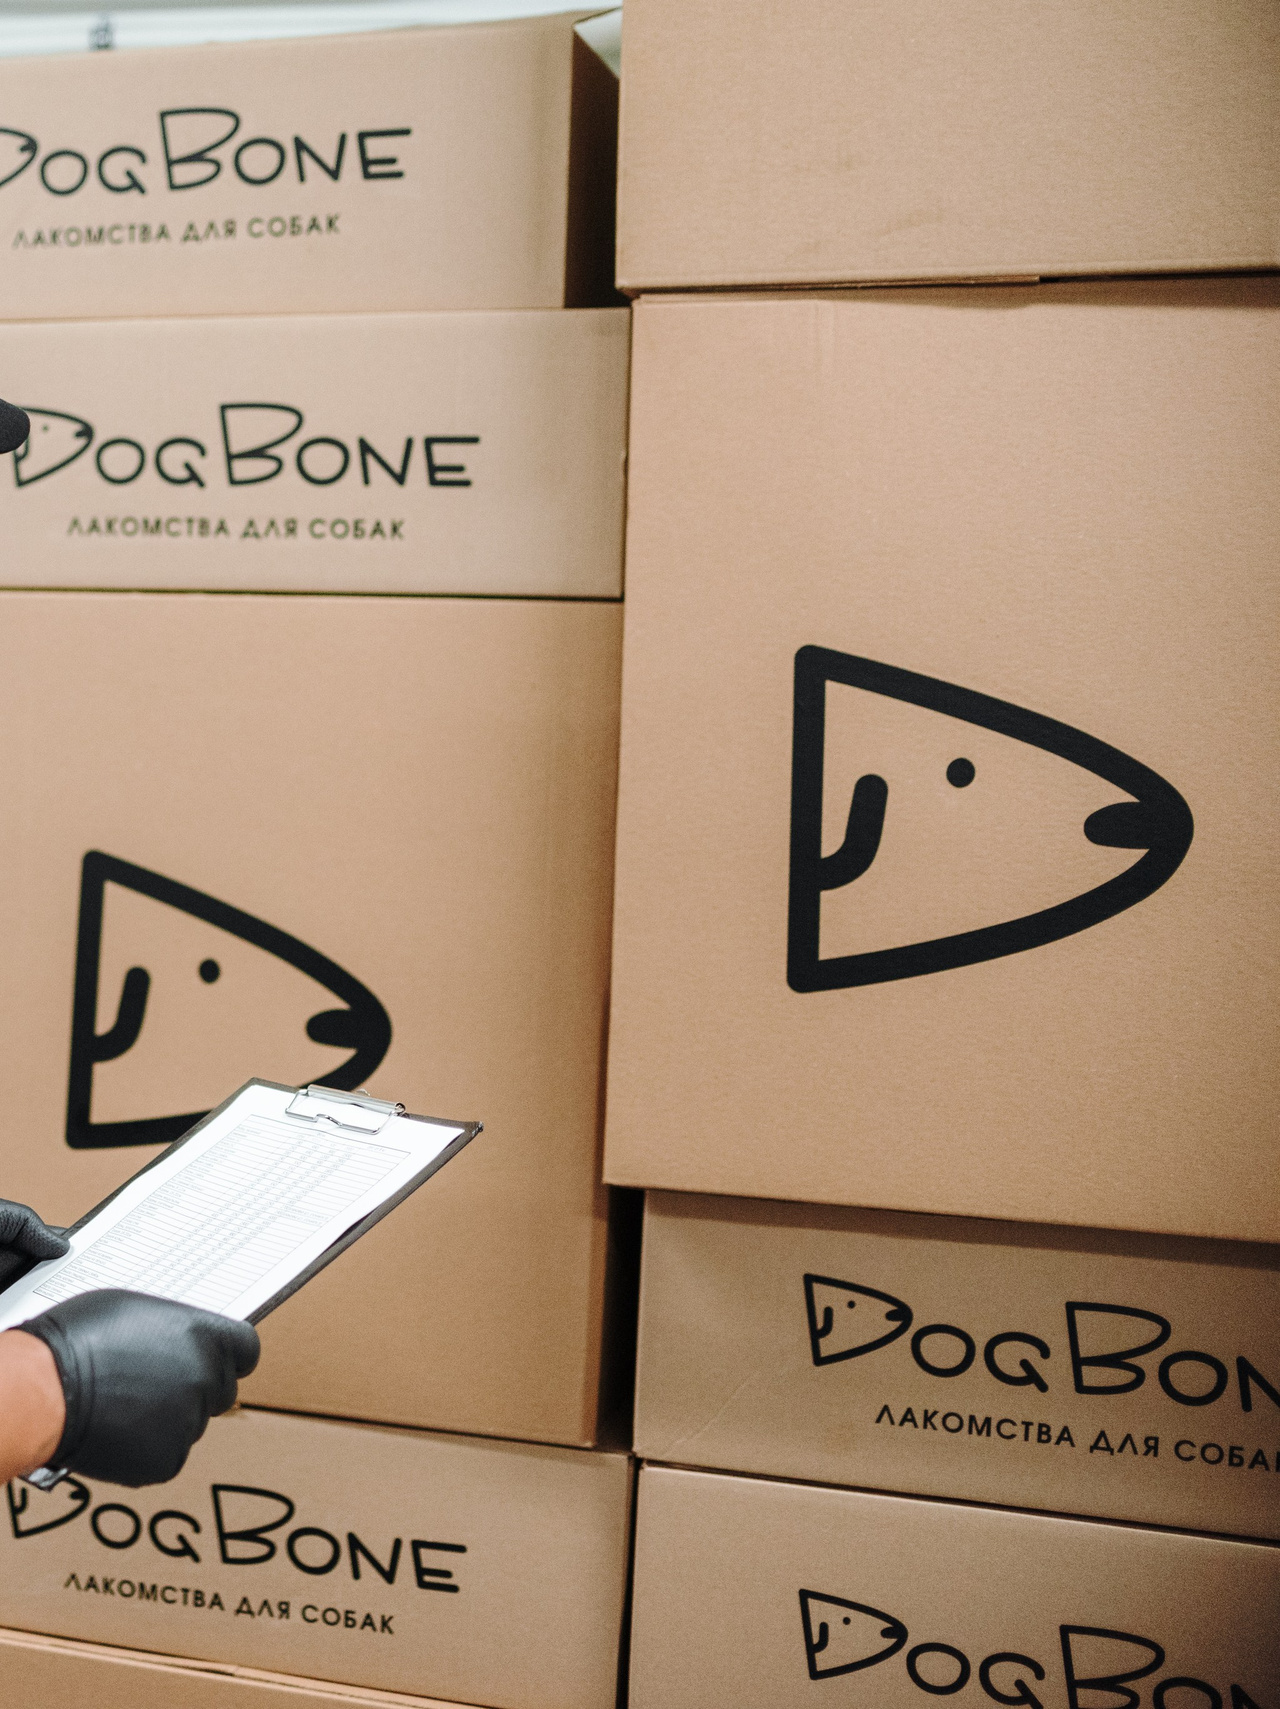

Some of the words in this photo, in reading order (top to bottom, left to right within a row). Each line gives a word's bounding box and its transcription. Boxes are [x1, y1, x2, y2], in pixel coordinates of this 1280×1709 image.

[12, 222, 172, 249] ЛАКОМСТВА
[180, 218, 238, 244] ДЛЯ
[246, 213, 341, 239] СОБАК
[66, 515, 232, 538] ЛАКОМСТВА
[238, 517, 300, 541] ДЛЯ
[307, 517, 406, 541] СОБАК
[874, 1404, 1076, 1448] ЛАКОМСТВА
[1088, 1430, 1161, 1459] ДЛЯ
[1173, 1438, 1280, 1474] СОБА
[63, 1572, 226, 1612] ЛАКОМСТВА
[234, 1595, 292, 1620] ДЛЯ
[299, 1602, 396, 1635] СОБАК
